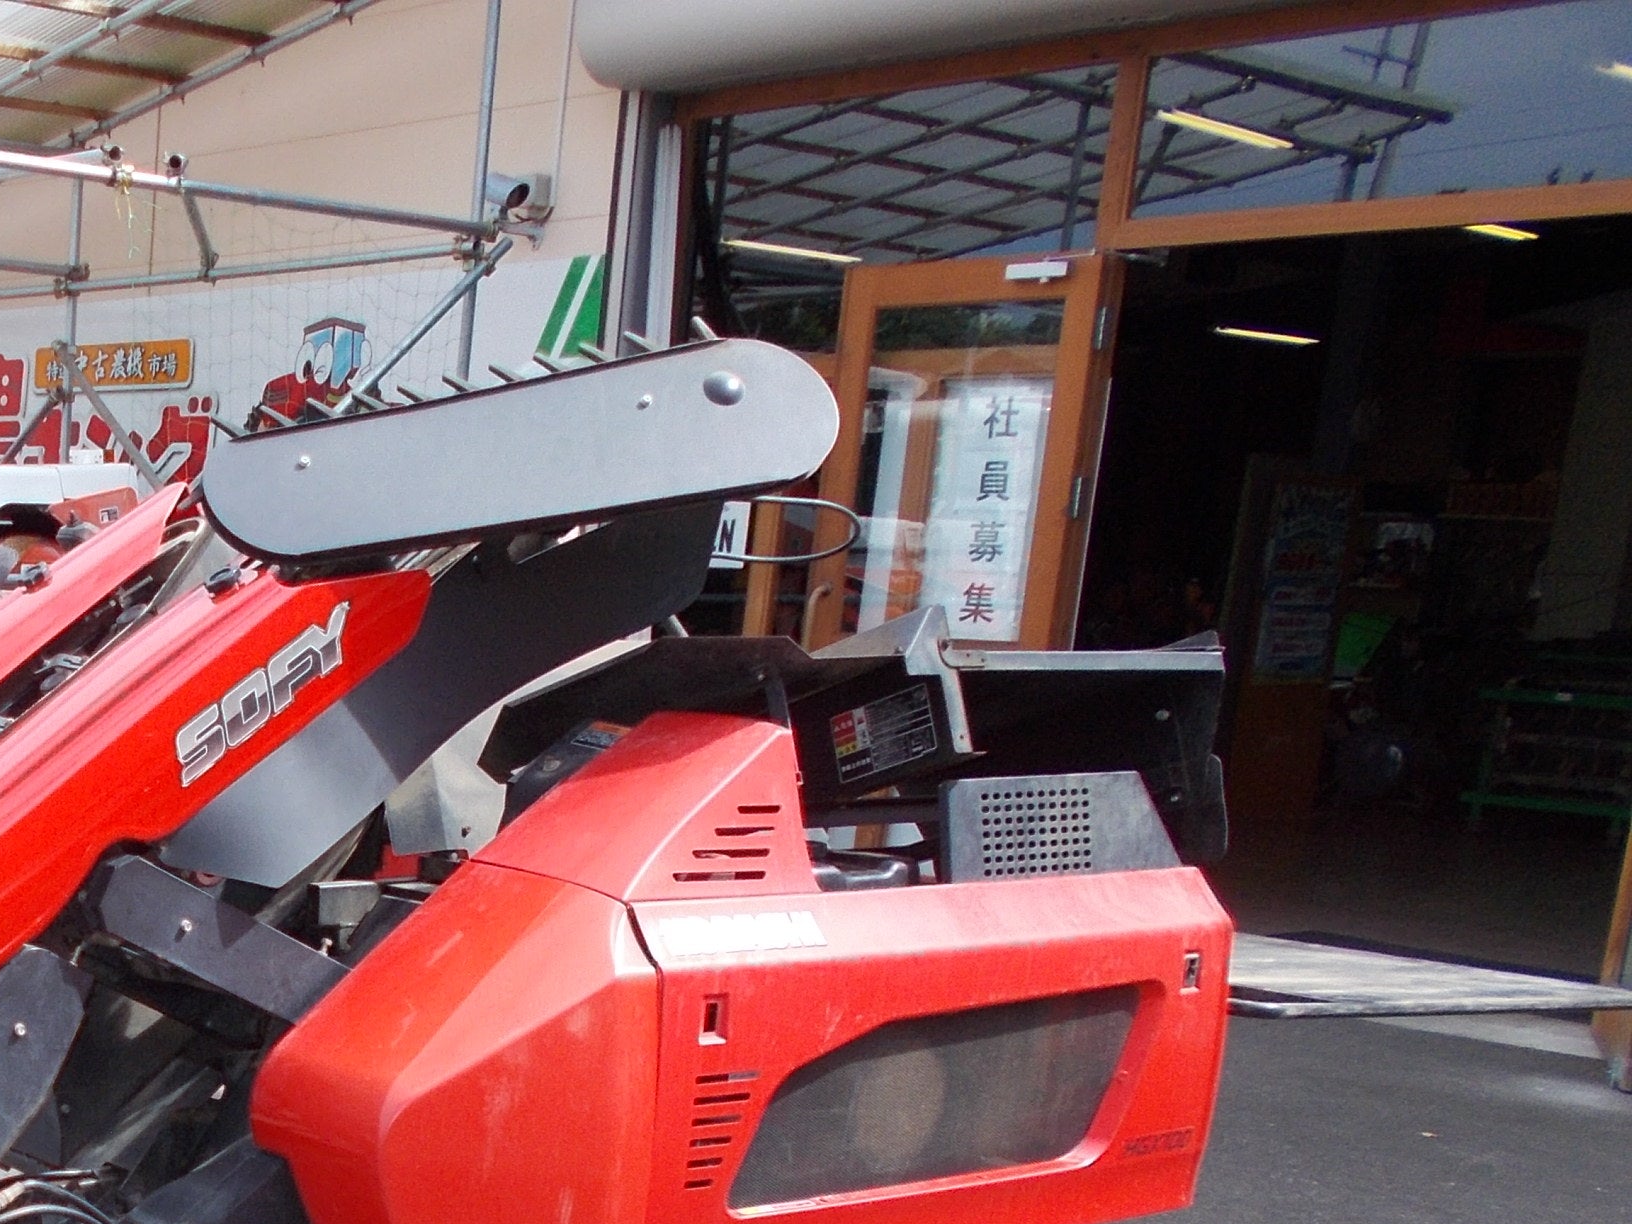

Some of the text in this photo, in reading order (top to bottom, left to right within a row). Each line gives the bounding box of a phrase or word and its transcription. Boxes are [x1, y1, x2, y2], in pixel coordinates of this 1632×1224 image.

[959, 397, 1019, 623] 社員募集
[175, 600, 351, 787] SOFY
